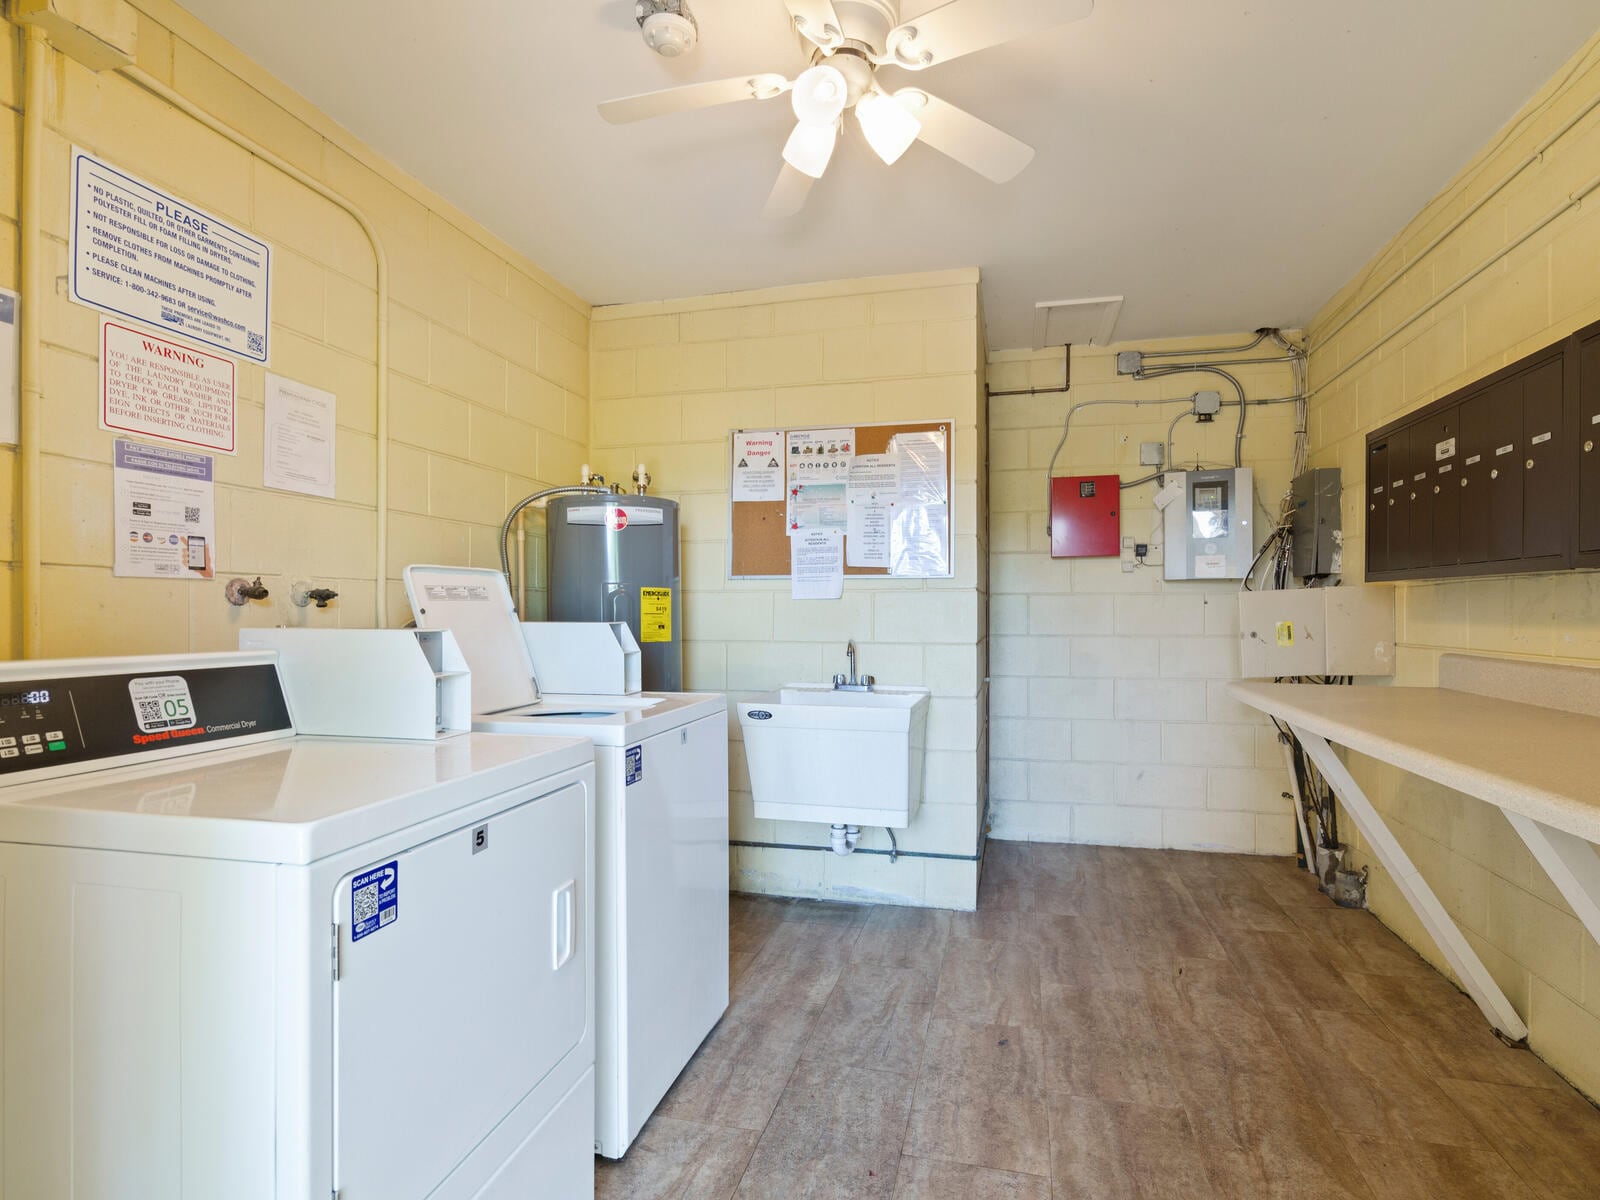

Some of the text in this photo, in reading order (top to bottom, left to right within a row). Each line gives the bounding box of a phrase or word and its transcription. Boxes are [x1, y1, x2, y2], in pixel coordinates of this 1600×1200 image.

[93, 185, 260, 268] NO PLASTIC, QUILTED, OR OTHER GARMENTS CONTAINING
[93, 196, 232, 265] POLYESTER FILL OR FOAM FILLING IN DRYERS.
[156, 201, 209, 235] PLEASE
[92, 237, 138, 261] COMPLETION.
[92, 226, 252, 298] REMOVE CLOTHES FROM MACHINES PROMPTLY AFTER
[93, 211, 256, 288] NOT RESPONSIBLE FOR LOSS OR DAMAGE TO CLOTHING.
[92, 252, 216, 307] PLEASE CLEAN MACHINES AFTER USING.
[92, 268, 123, 286] SERVICE:
[125, 280, 176, 305] 1-800-342-9683
[178, 300, 186, 308] OR
[188, 305, 246, 332] service@washco.com
[110, 350, 127, 360] YOU
[130, 356, 147, 366] ARE
[149, 360, 200, 380] RESPONSIBLE
[213, 378, 230, 390] USER
[142, 340, 204, 369] WARNING
[110, 360, 230, 399] OF THE LAUNDRY EQUIPMENT
[110, 368, 230, 406] TO CHECK EACH WASHER AND
[110, 379, 231, 416] DRYER FOR GREASE, LIPSTICK,
[110, 398, 230, 431] EIGN OBJECTS OR MATERIALS
[132, 392, 147, 402] INK
[150, 397, 161, 406] OR
[164, 401, 190, 413] OTHER
[193, 408, 213, 419] SUCH
[110, 406, 142, 420] BEFORE
[144, 414, 185, 429] INSERTING
[164, 698, 189, 717] 05
[132, 720, 257, 744] Speed Queen Commercial Dryer
[476, 830, 485, 847] 5
[352, 869, 385, 889] SCAN HERE
